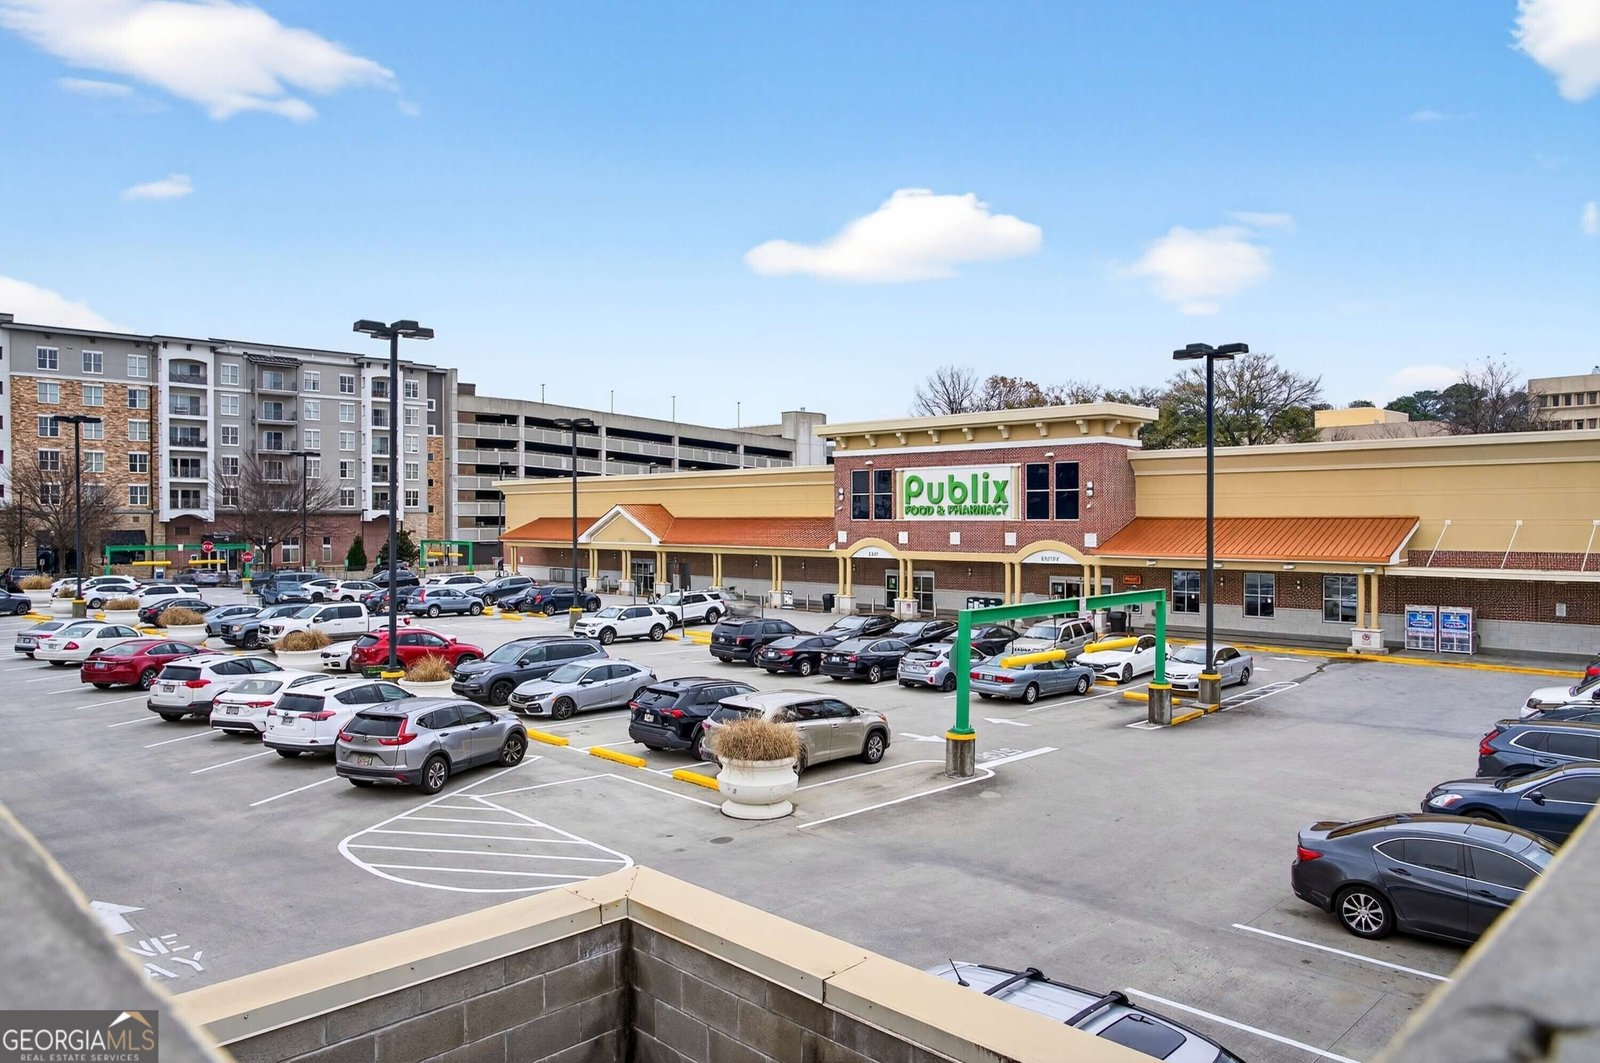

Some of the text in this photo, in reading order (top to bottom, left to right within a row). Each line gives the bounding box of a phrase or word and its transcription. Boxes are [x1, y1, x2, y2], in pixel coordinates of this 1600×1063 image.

[905, 472, 1009, 505] Publix
[905, 504, 1009, 516] FOOD & PHARMACY
